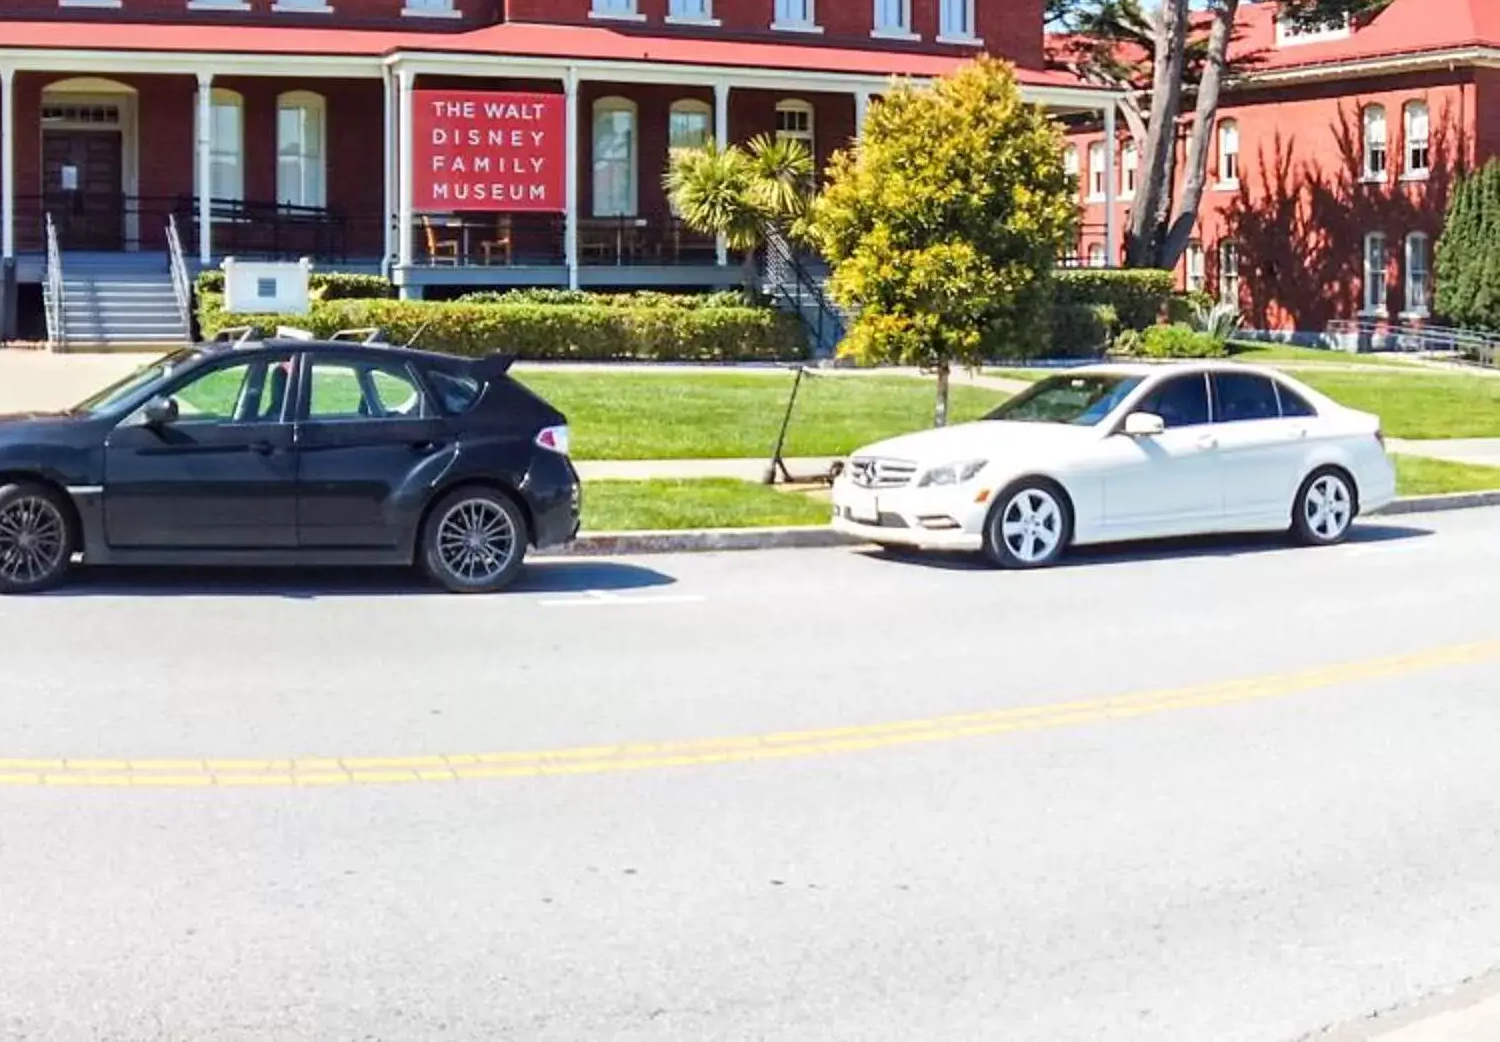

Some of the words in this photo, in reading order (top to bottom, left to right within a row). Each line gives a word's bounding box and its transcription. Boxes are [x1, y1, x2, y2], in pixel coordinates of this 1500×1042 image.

[432, 101, 475, 118] THE
[484, 104, 544, 120] WALT
[433, 129, 544, 146] DISNEY
[433, 156, 543, 172] FAMILY
[433, 184, 545, 200] MUSEUM
